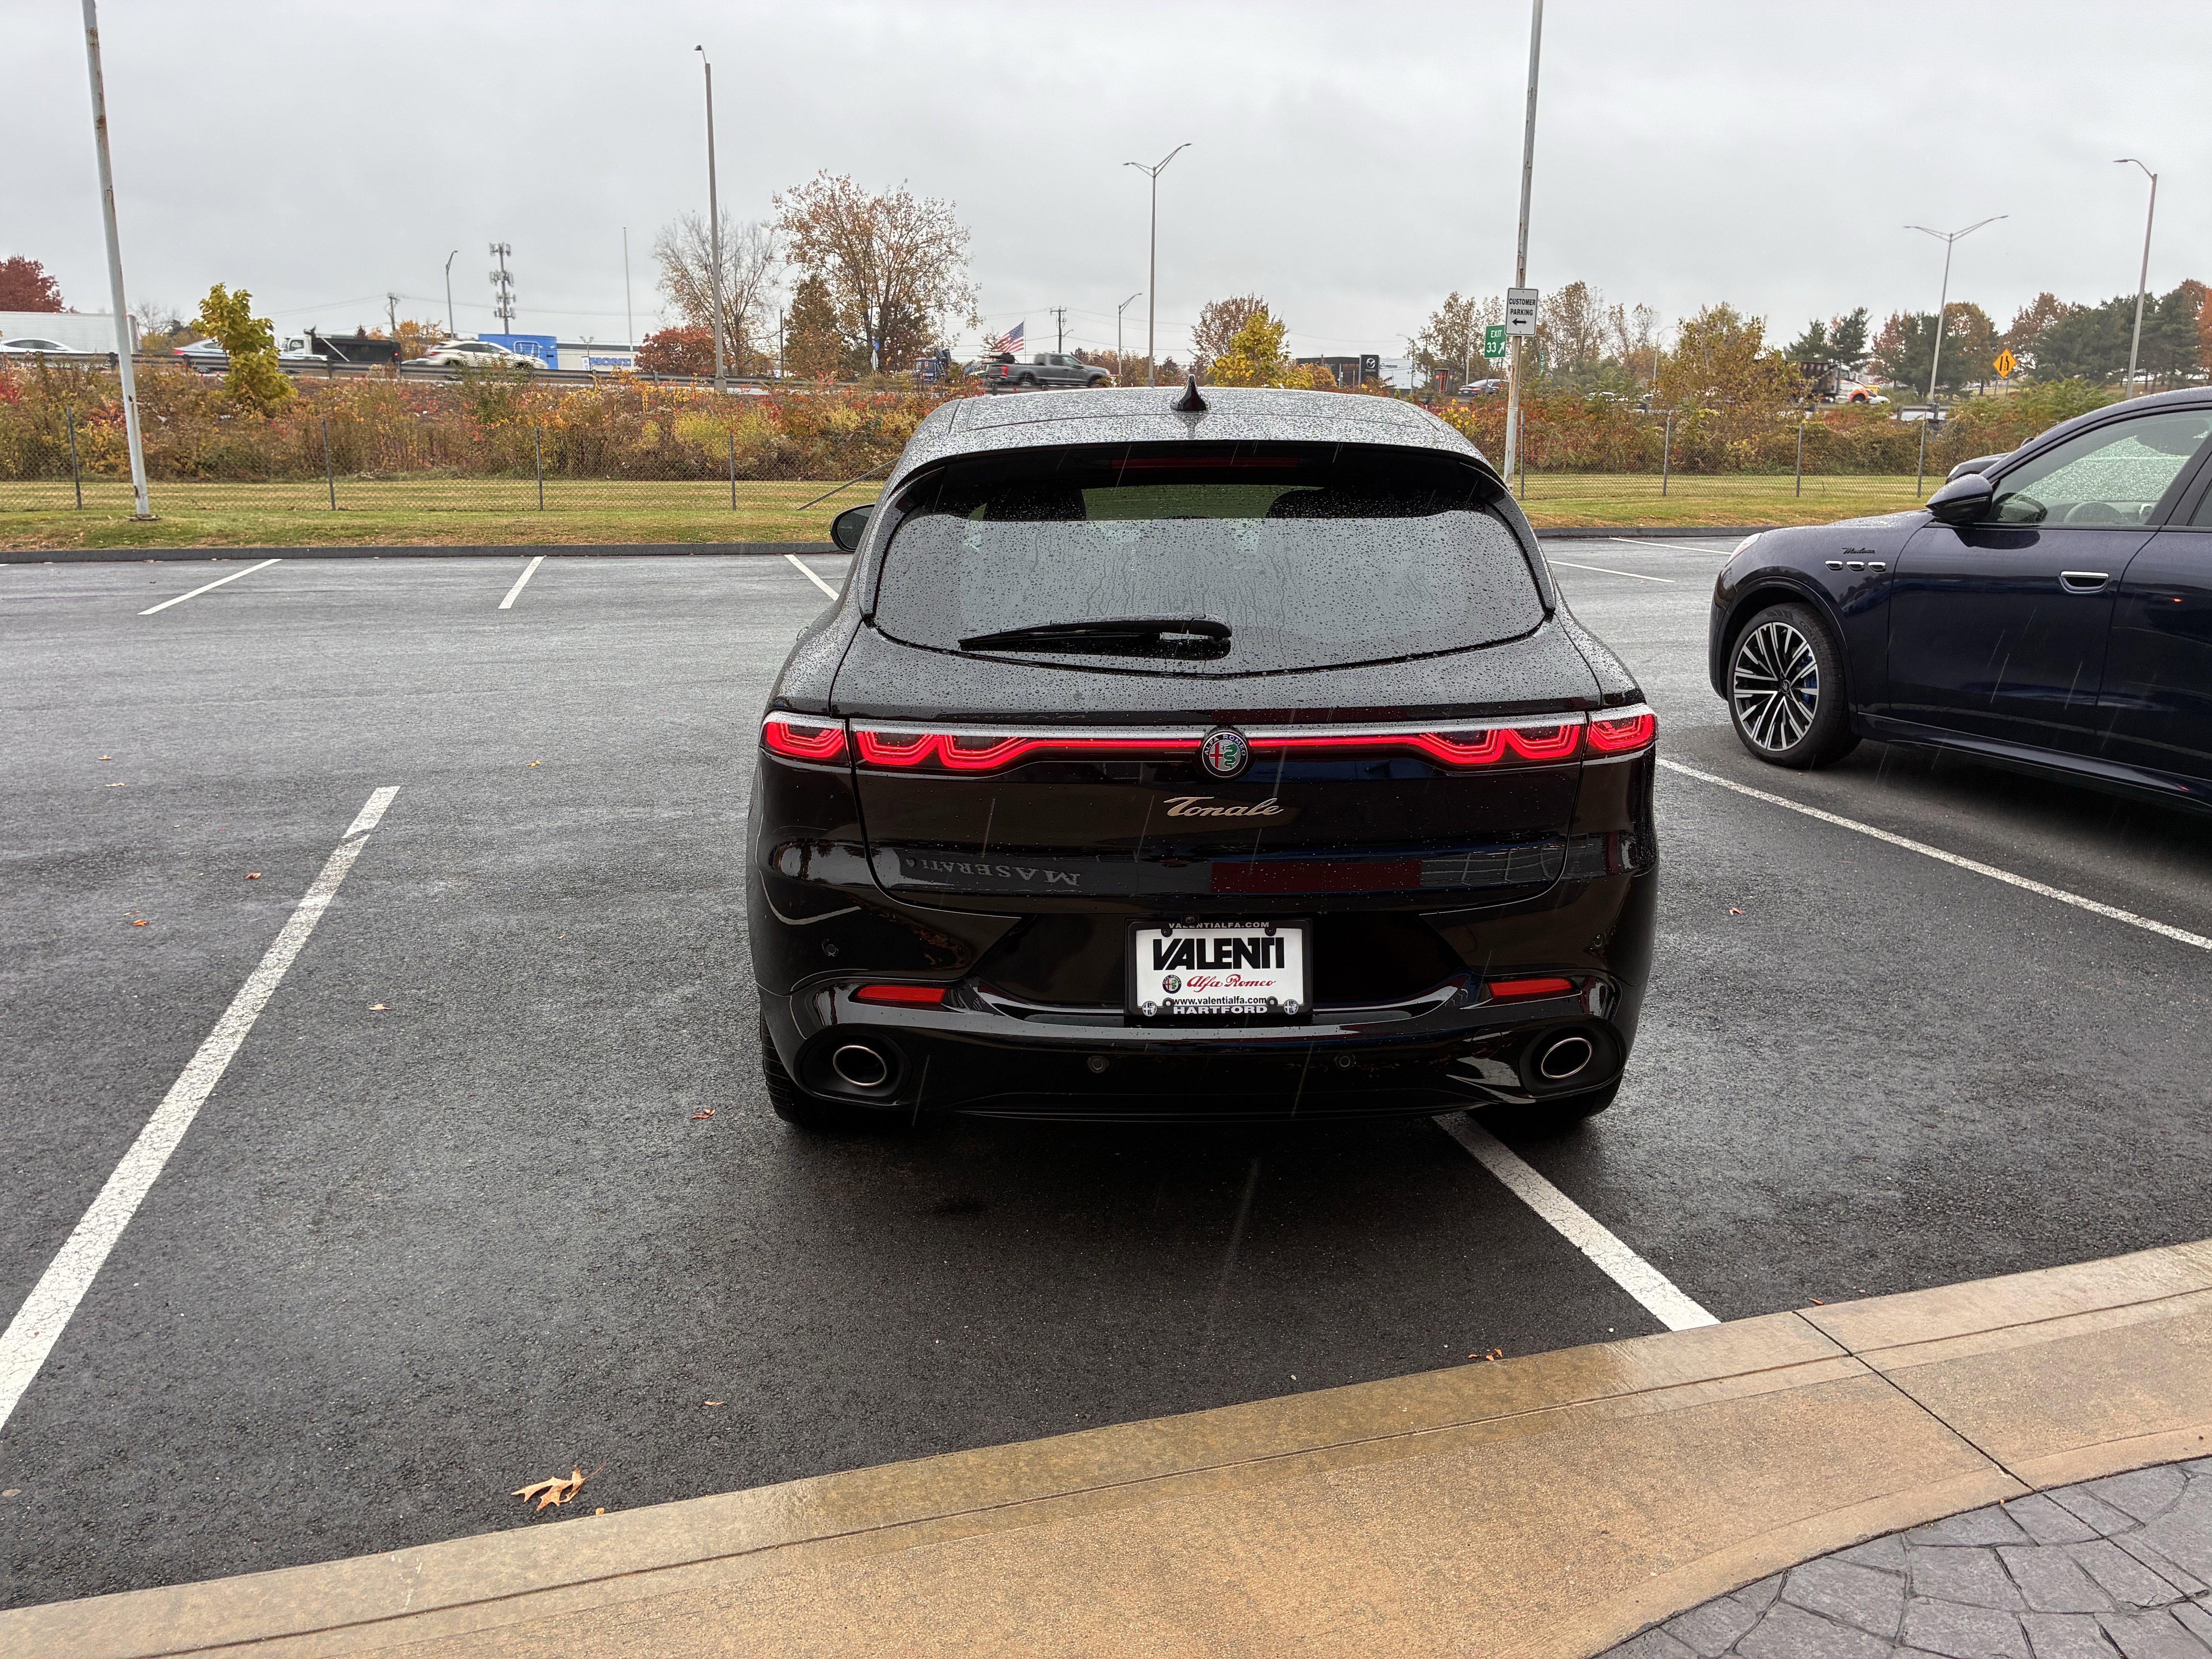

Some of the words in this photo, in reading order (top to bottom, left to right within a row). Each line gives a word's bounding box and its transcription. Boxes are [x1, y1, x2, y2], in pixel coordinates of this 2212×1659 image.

[1486, 342, 1496, 353] 33
[1204, 737, 1219, 756] ALFA
[1223, 734, 1246, 756] ROMEO
[1164, 797, 1284, 816] Tonale
[1153, 937, 1285, 970] VALENTI
[1187, 976, 1223, 993] Alfa
[1224, 974, 1276, 987] Romeo
[1173, 996, 1267, 1005] www.valentialfa.com
